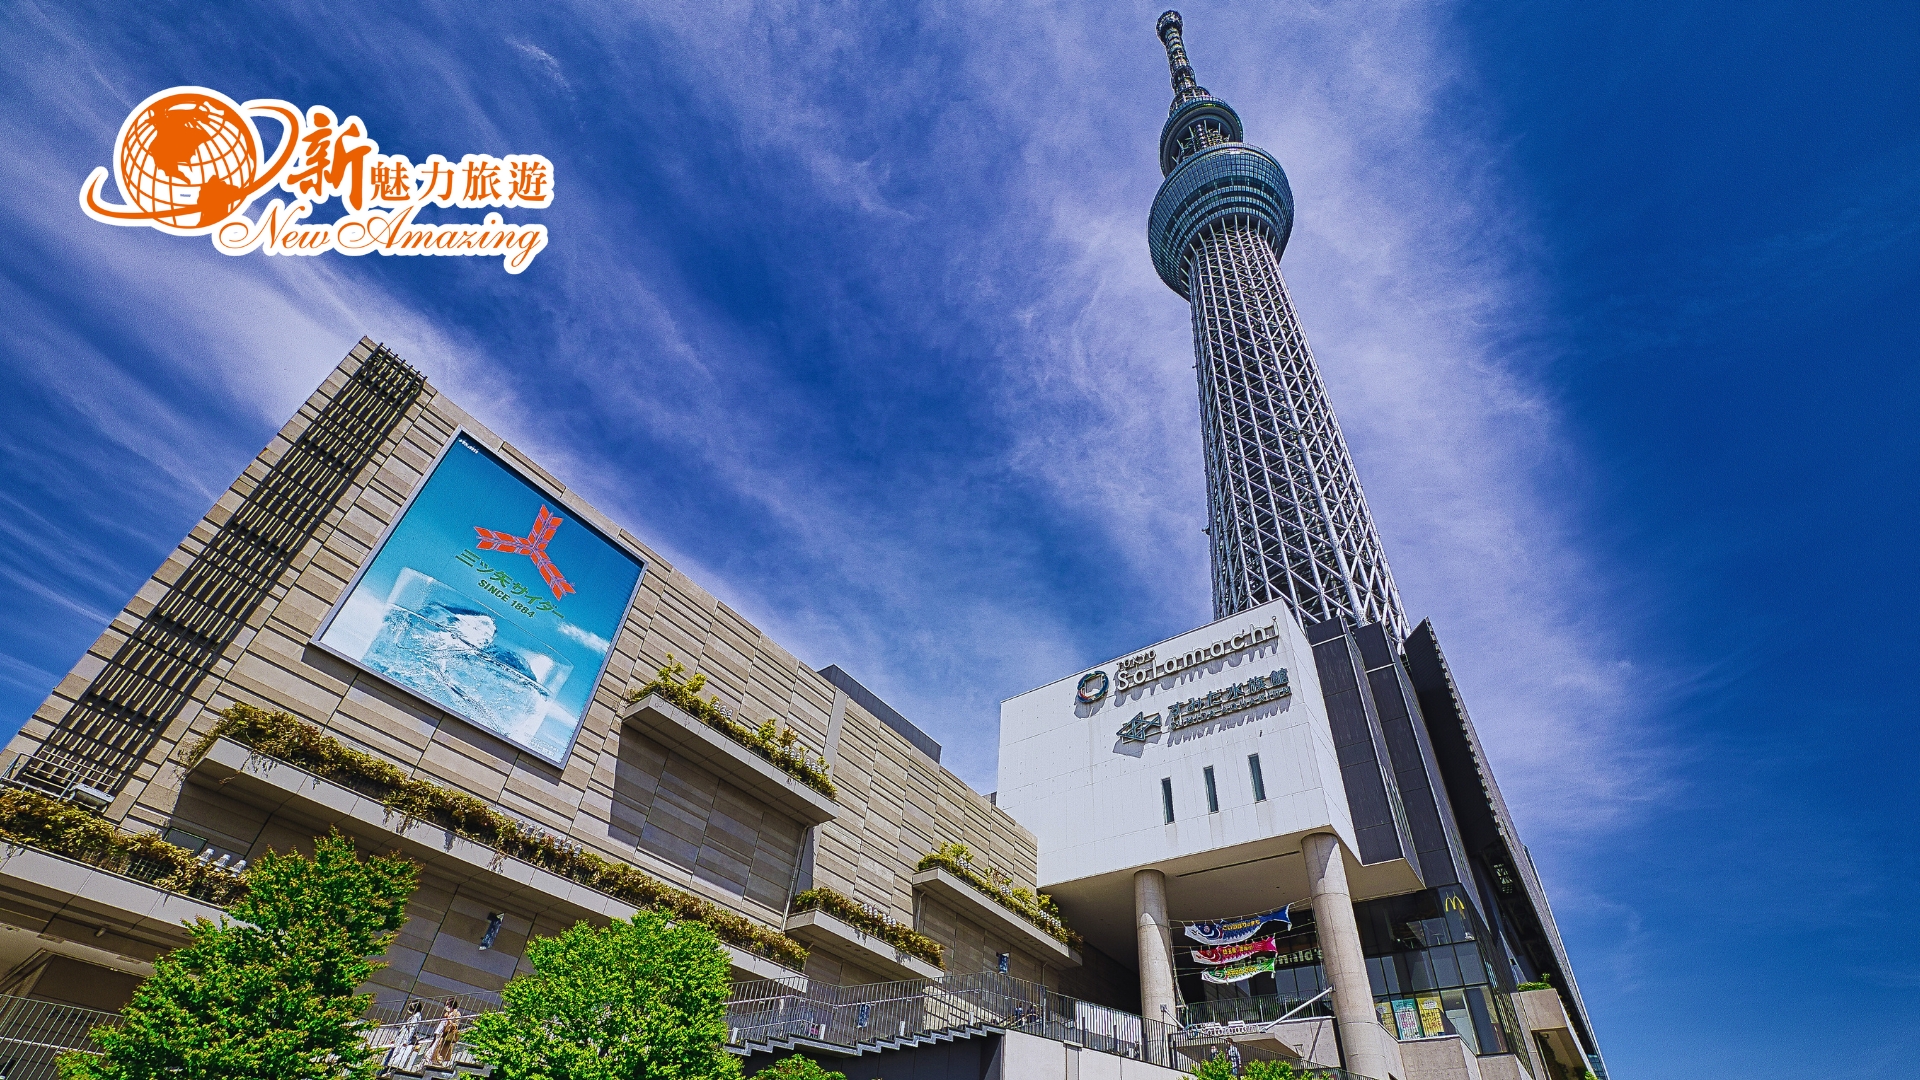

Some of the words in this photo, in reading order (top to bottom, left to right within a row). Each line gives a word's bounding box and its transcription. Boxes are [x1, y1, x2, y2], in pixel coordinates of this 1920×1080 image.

[455, 549, 565, 619] 三ツ矢サイダー
[478, 579, 510, 603] SINCE
[511, 600, 536, 618] 1884
[1117, 615, 1280, 691] Solamachi
[1168, 667, 1289, 716] すみだ水族館
